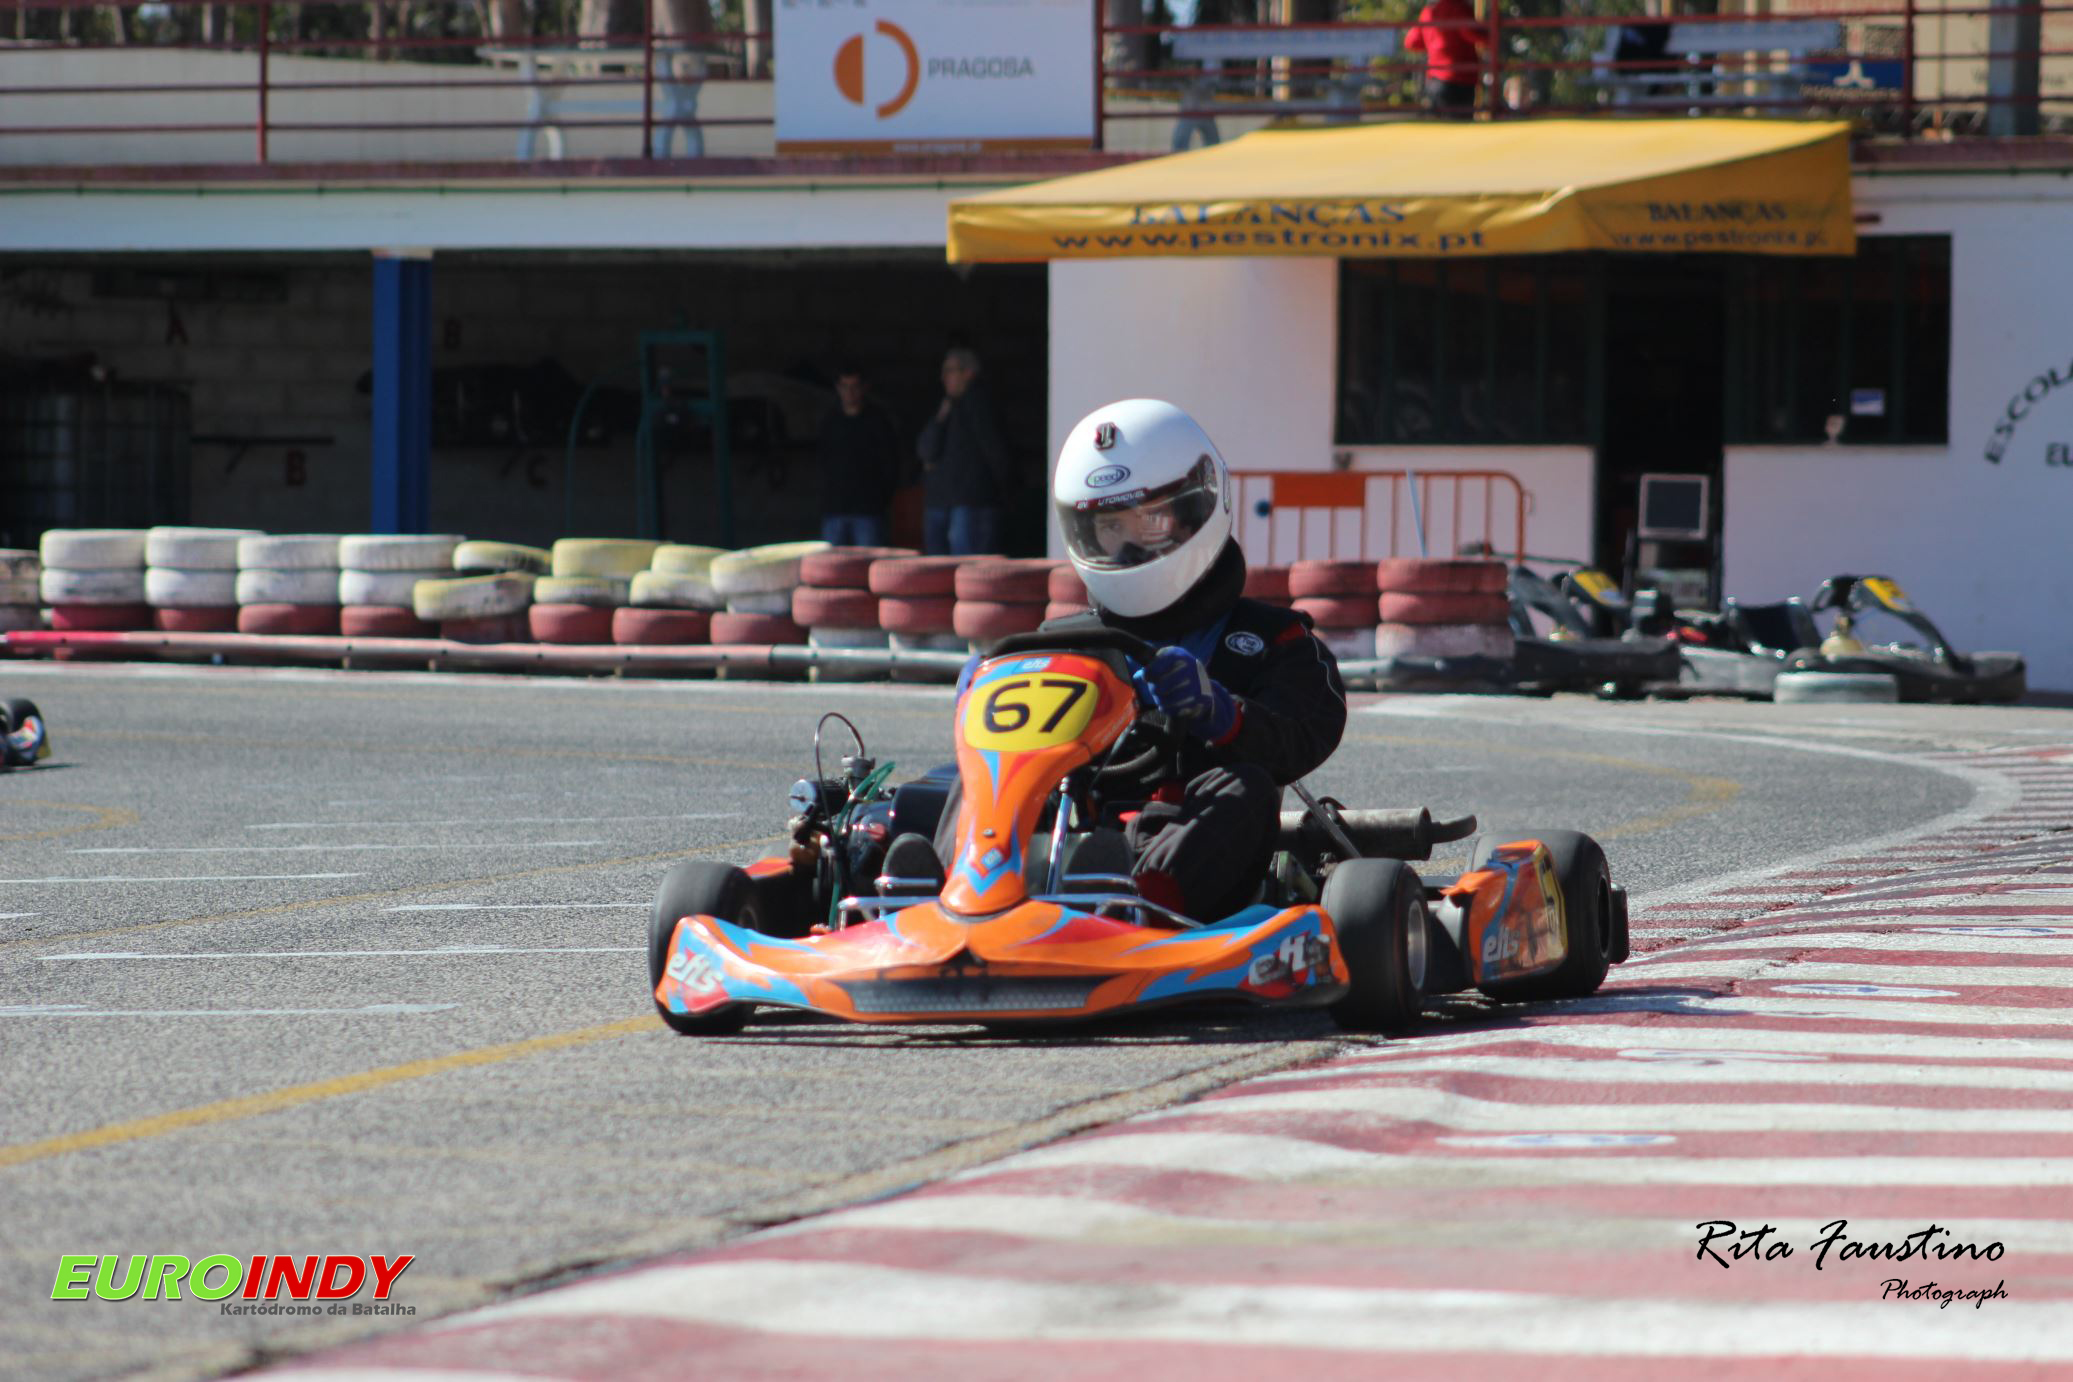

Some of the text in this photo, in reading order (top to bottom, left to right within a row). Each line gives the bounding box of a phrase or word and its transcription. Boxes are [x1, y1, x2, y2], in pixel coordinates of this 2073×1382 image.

[928, 57, 1034, 79] PRAGOSA
[1053, 230, 1485, 251] www.pestronix.pt
[1984, 359, 2073, 465] ESCOL
[983, 679, 1088, 734] 67
